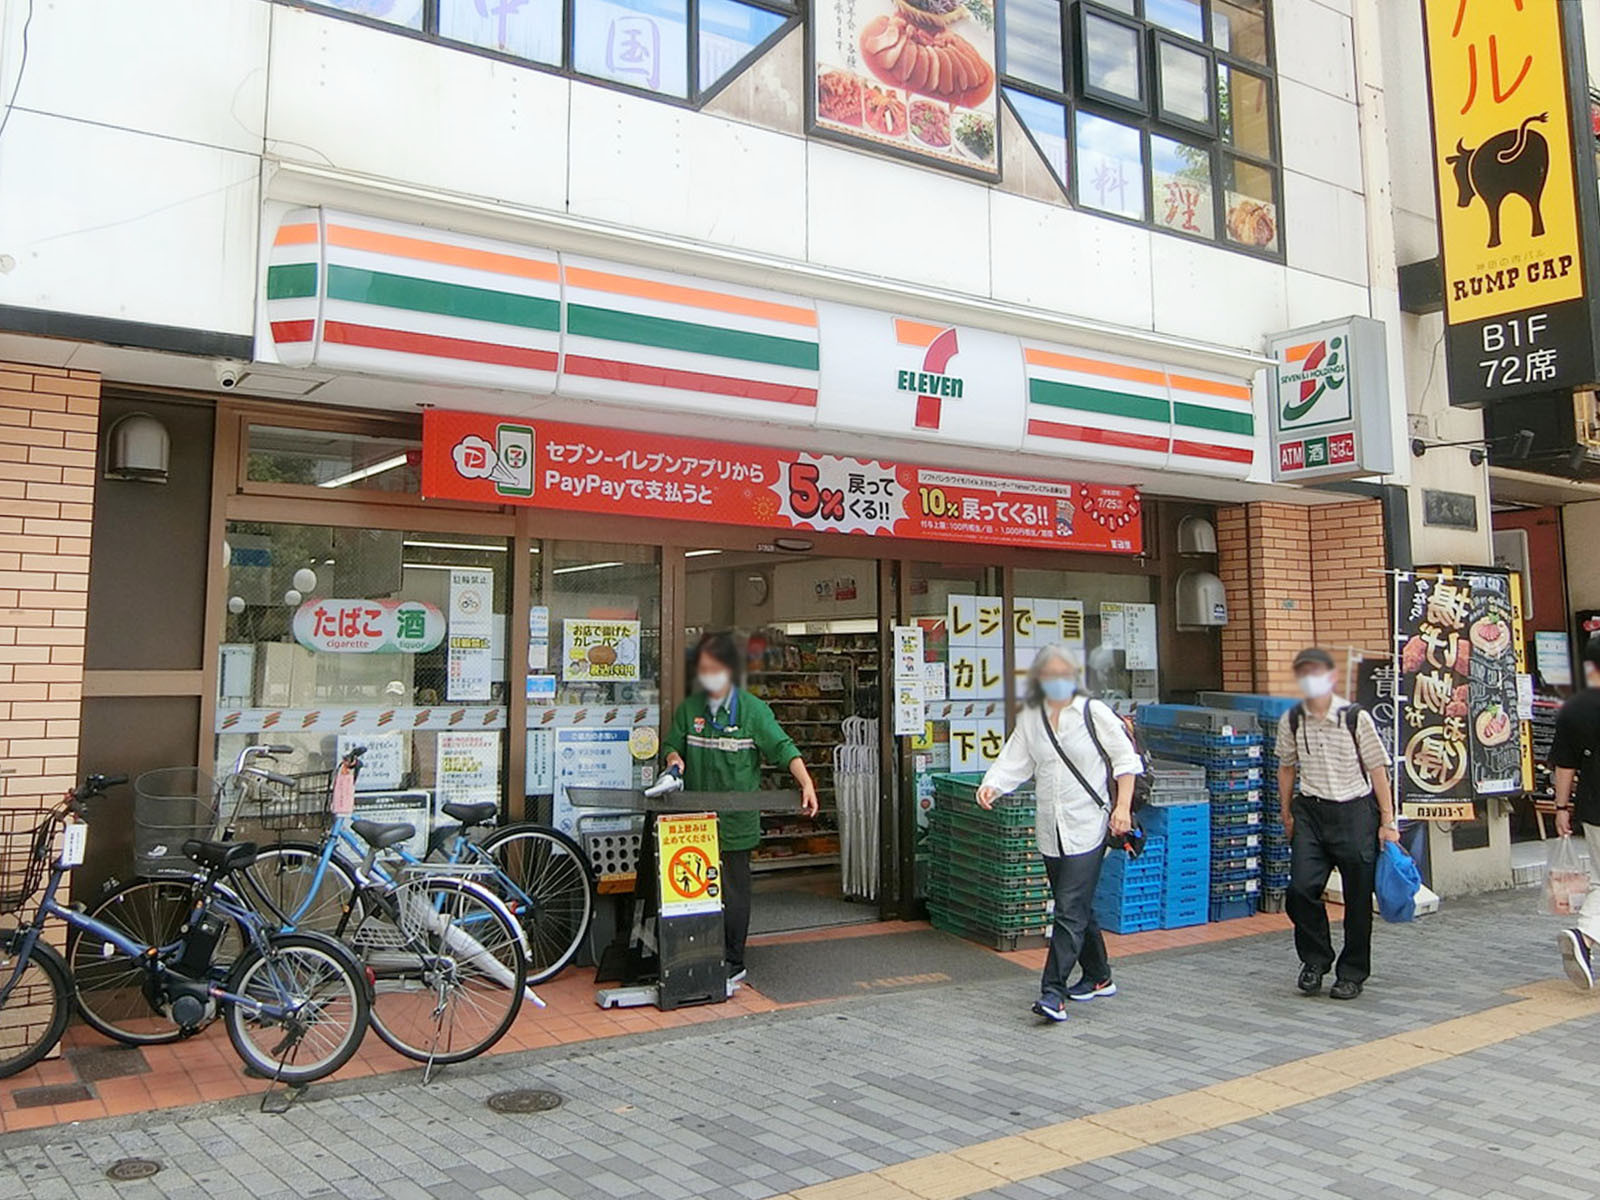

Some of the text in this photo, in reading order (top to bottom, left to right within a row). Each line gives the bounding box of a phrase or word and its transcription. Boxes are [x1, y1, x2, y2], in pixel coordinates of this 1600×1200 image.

[606, 17, 661, 89] 国
[1092, 156, 1202, 233] 料 理
[1453, 255, 1572, 301] RUMP CAP
[1483, 314, 1548, 351] B1F
[1480, 349, 1557, 387] 72席
[897, 369, 964, 398] ELEVEN
[1281, 446, 1304, 466] ATM
[1308, 443, 1324, 462] 酒
[1330, 439, 1353, 458] たばこ
[545, 470, 713, 505] PayPayで支払うと
[789, 462, 845, 522] 5%
[848, 473, 894, 496] 戻って
[313, 606, 426, 638] たばこ 酒
[573, 625, 631, 638] お店で揚げた
[326, 640, 369, 648] cigarette
[574, 636, 620, 647] カレーパン
